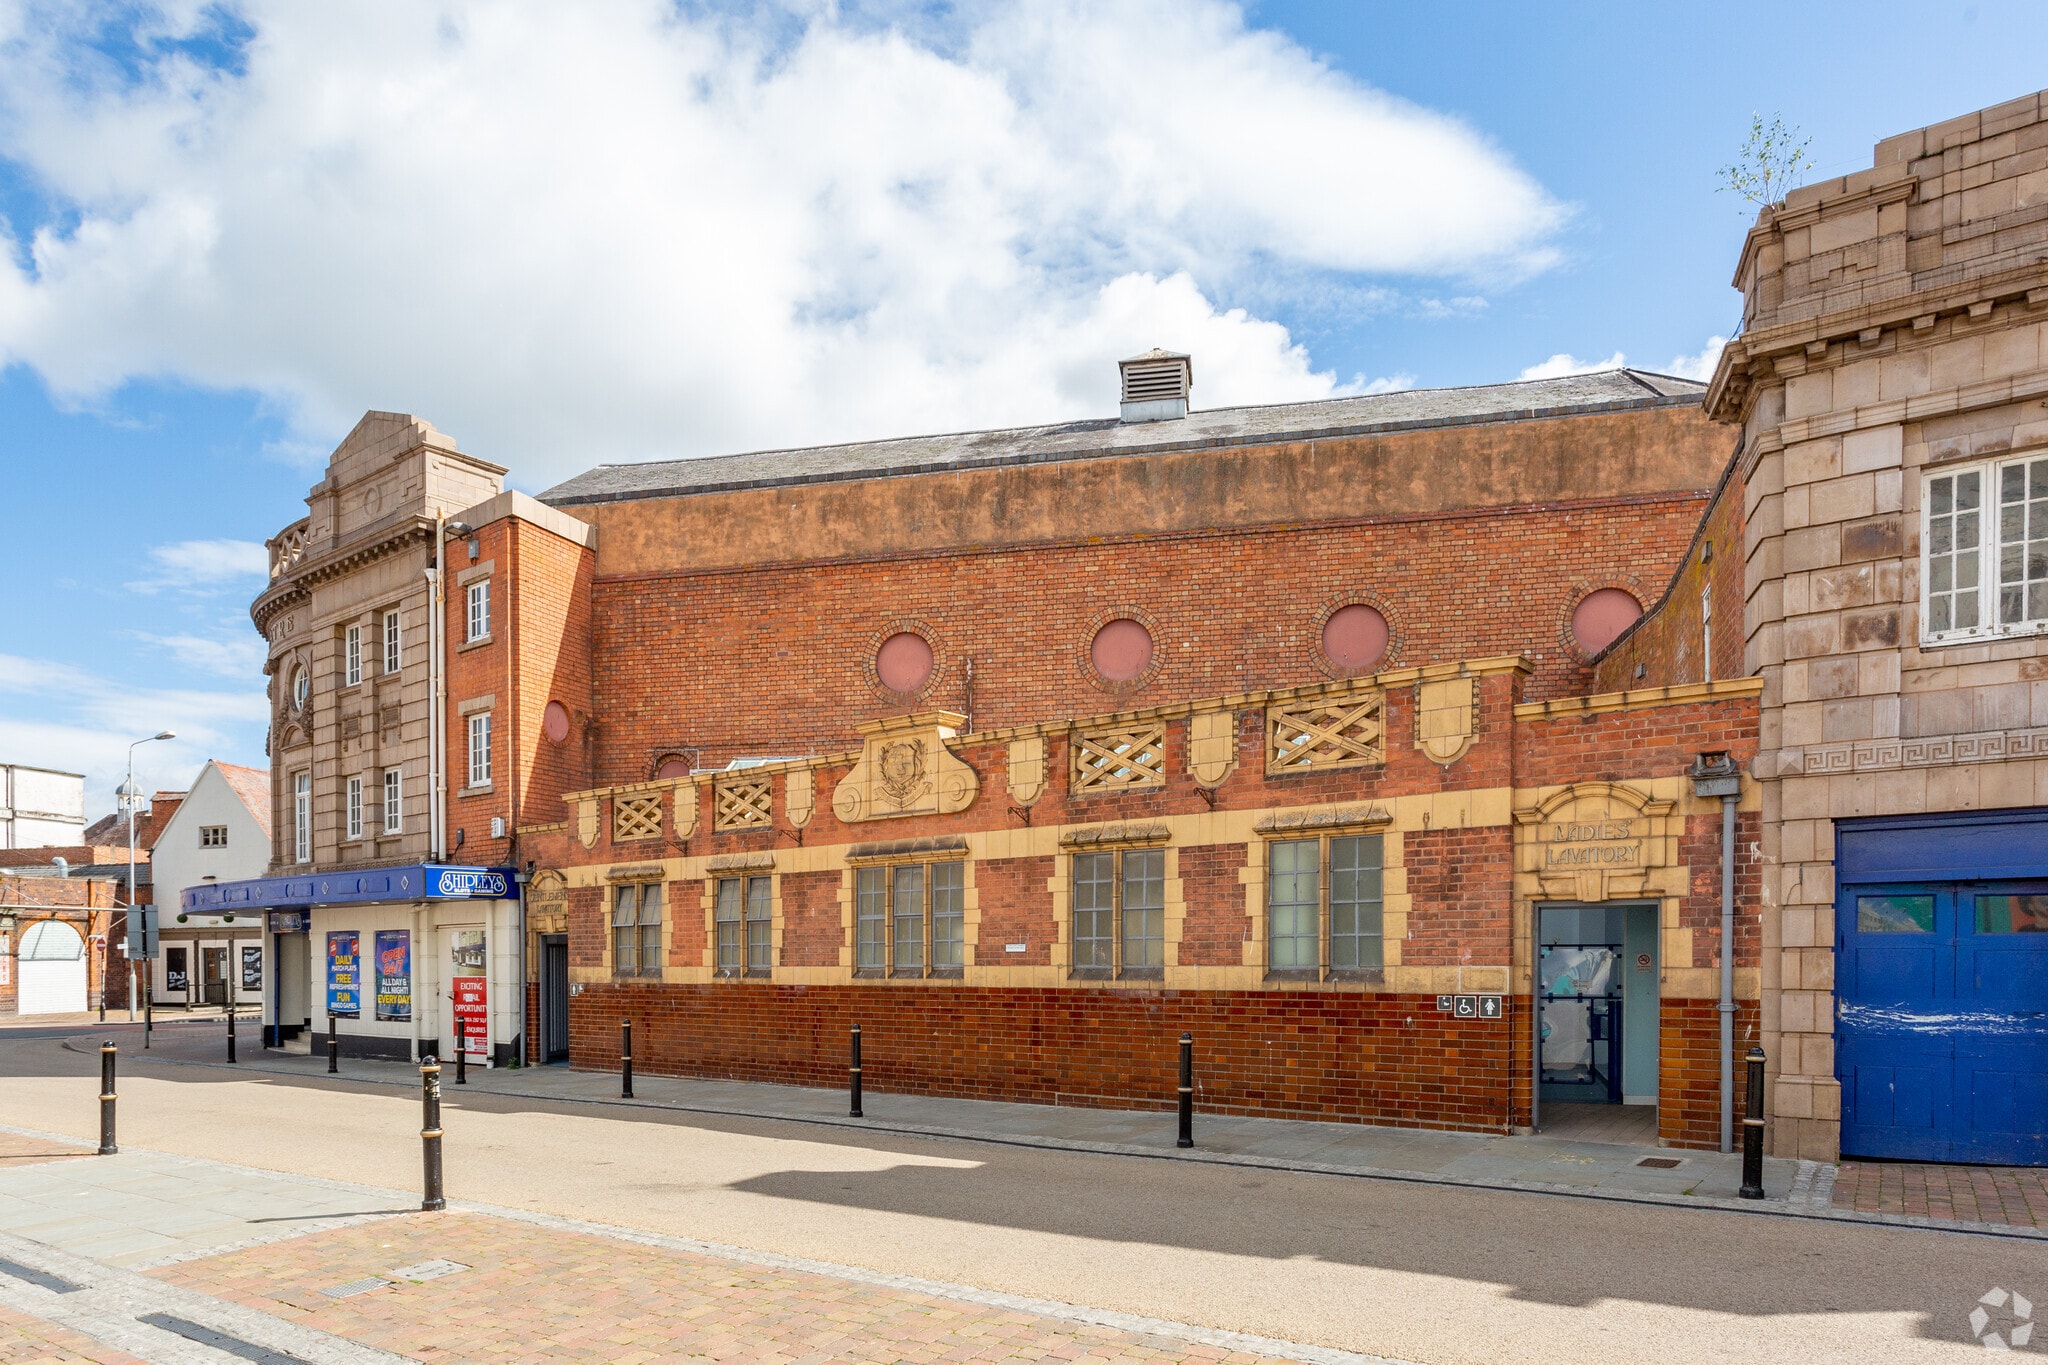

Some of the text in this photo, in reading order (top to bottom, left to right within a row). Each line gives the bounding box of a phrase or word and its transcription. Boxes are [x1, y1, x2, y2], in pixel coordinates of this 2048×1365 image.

[1548, 845, 1639, 865] LAVATORY
[442, 874, 504, 892] SHIPLEYS
[336, 955, 353, 965] DAILY
[382, 946, 405, 964] OPEN
[384, 960, 403, 975] 24/7
[336, 973, 351, 984] FREE
[381, 978, 392, 986] ALL
[392, 978, 402, 986] DAY
[380, 986, 409, 995] ALL NIGHT!
[460, 982, 483, 991] EXCITING
[337, 992, 350, 1002] FUN
[378, 995, 411, 1004] EVERY DAY!
[463, 993, 481, 1002] RAIL
[466, 1026, 486, 1034] ENQUIRIES
